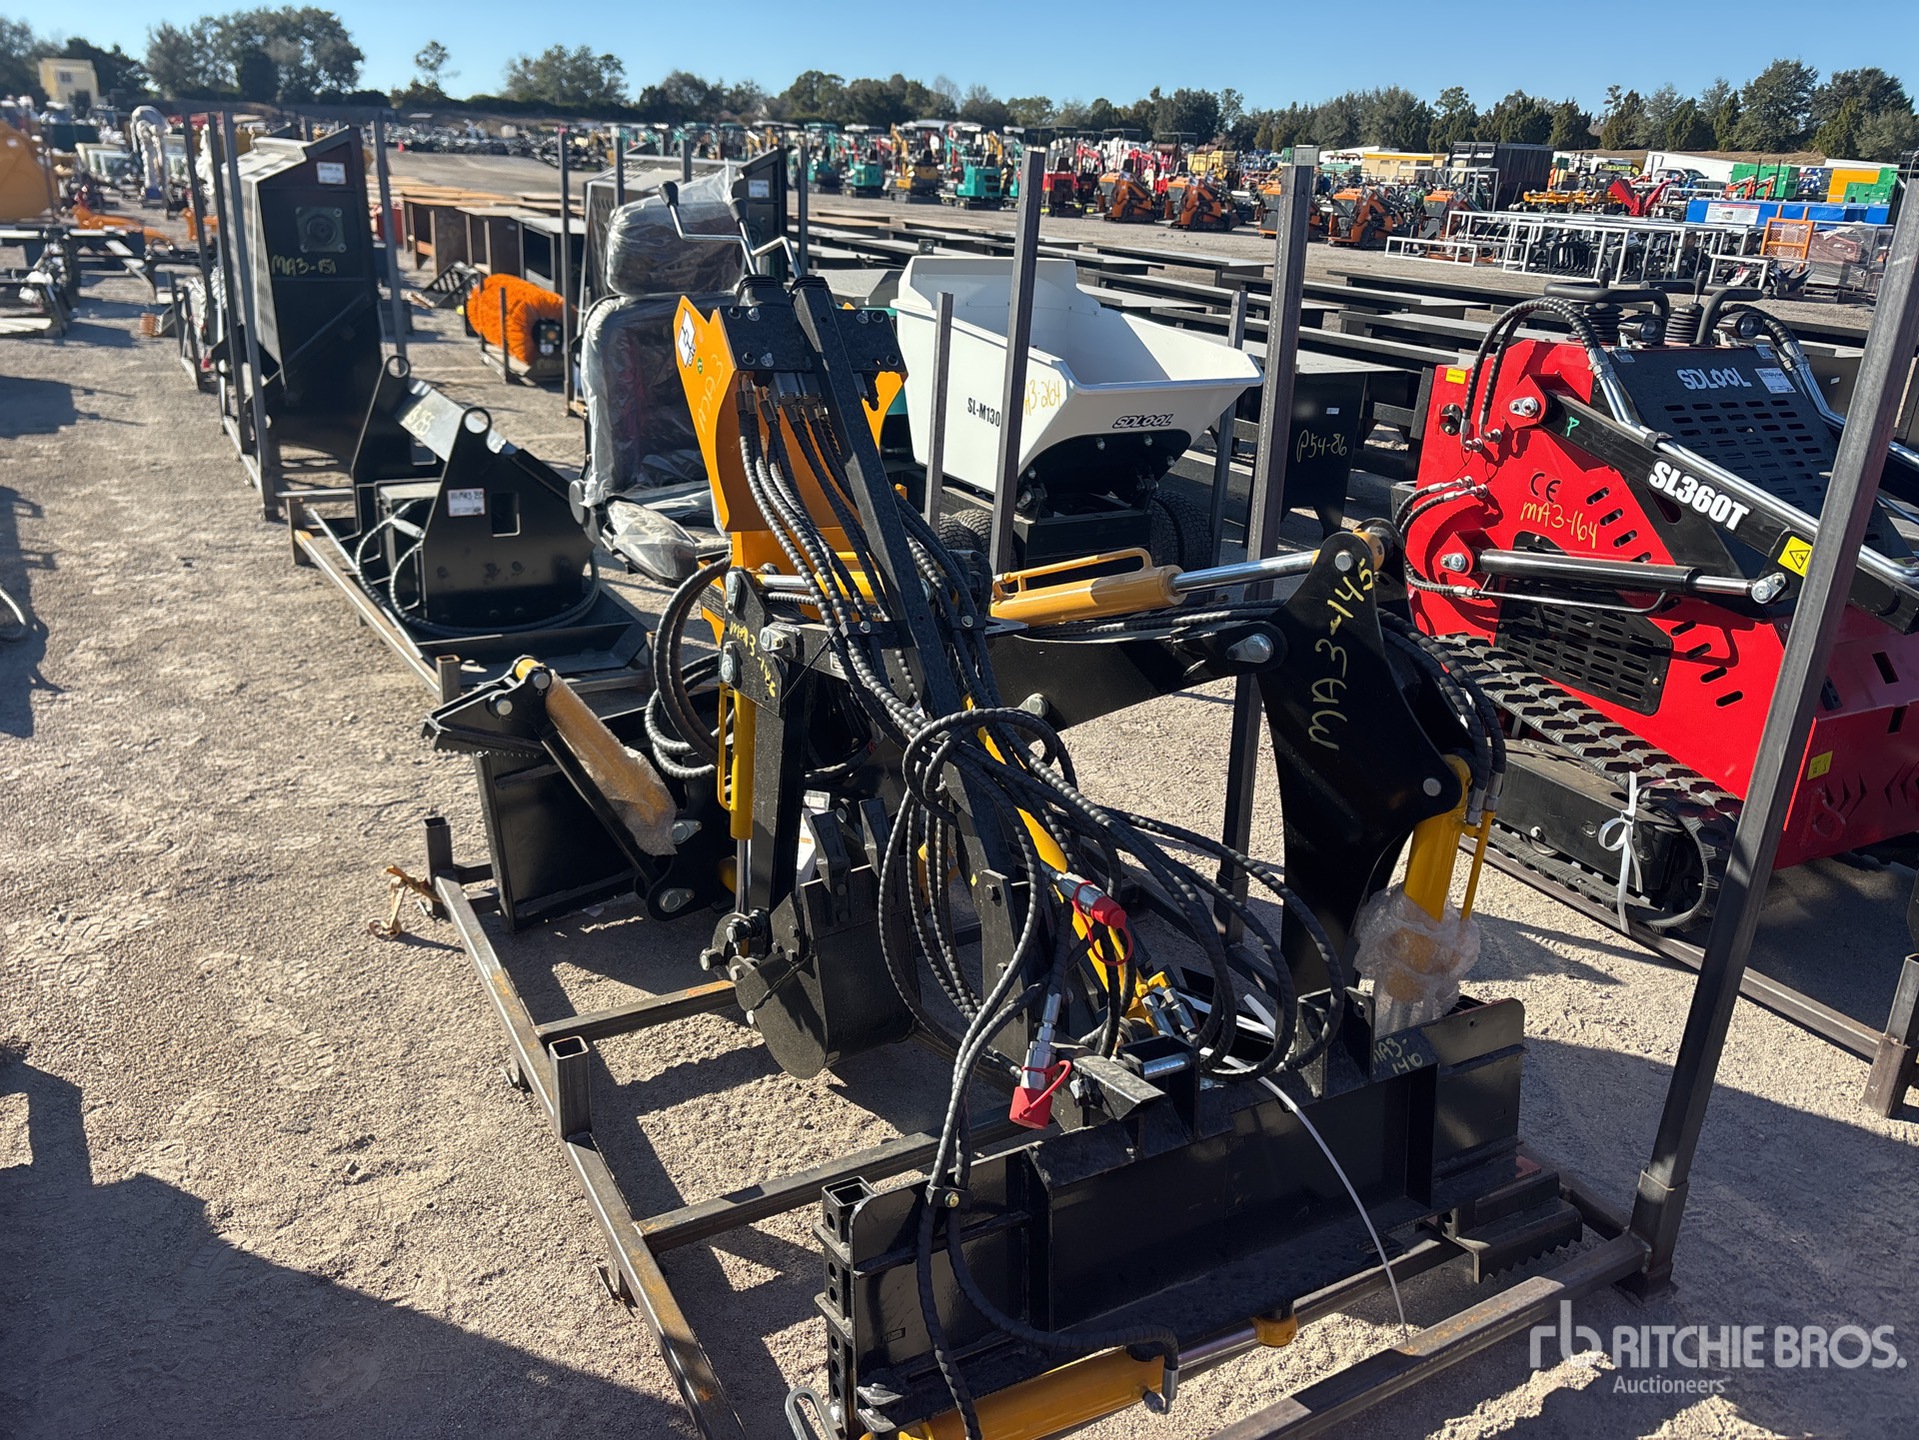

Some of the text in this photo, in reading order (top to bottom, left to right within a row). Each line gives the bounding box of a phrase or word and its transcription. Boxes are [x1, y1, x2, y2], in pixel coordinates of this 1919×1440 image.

[1676, 367, 1753, 390] SDLOOL
[967, 397, 1001, 428] SL-M130
[1024, 379, 1061, 417] A3-264
[1112, 413, 1174, 430] SDLOOL
[1648, 460, 1750, 532] SL360T
[1307, 557, 1374, 751] MA3-145
